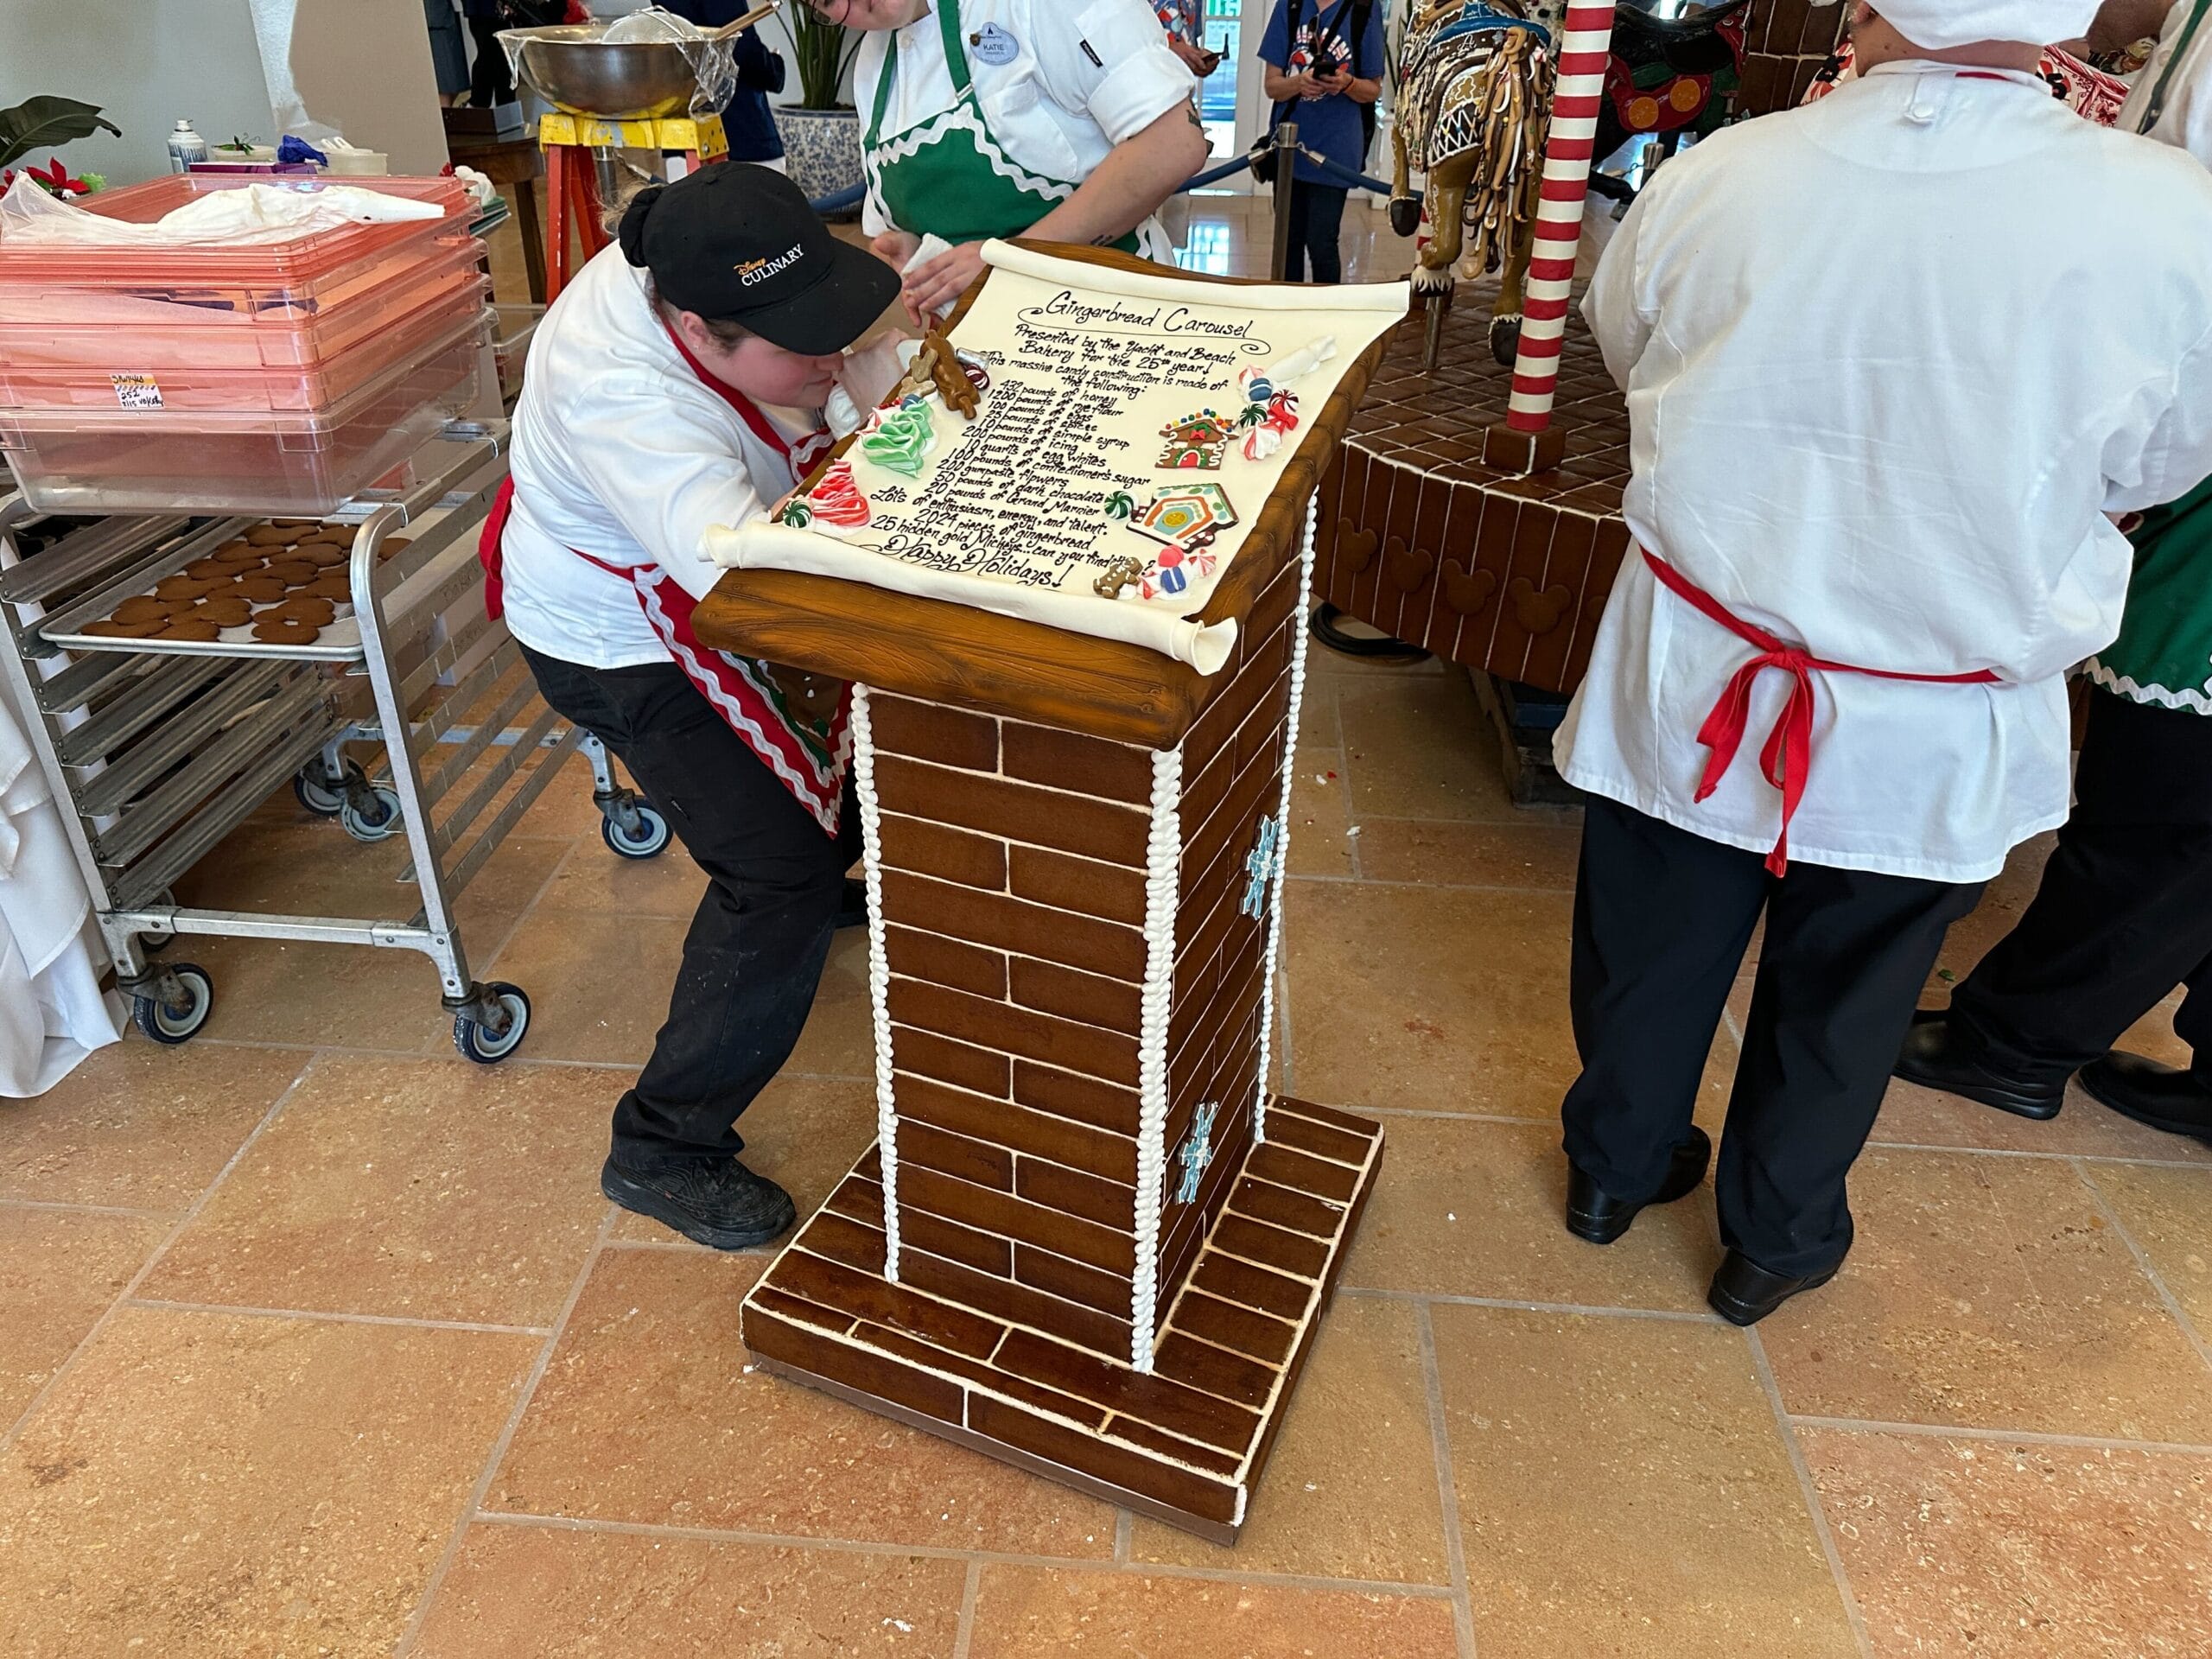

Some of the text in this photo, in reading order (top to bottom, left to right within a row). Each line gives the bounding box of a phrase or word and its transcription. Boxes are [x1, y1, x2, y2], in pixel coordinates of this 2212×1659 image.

[734, 243, 804, 287] Disney CULINARY
[1046, 290, 1253, 338] Gingerbread Carousel
[1014, 323, 1236, 365] Presented by the Yacht and Beach
[1019, 340, 1213, 375] Bakery for the 25th year!
[1009, 359, 1052, 372] massive
[1055, 365, 1090, 380] candy
[1093, 369, 1160, 385] construction
[1163, 375, 1173, 385] is
[1175, 378, 1207, 389] made
[1210, 379, 1229, 391] of
[1061, 375, 1147, 400] the following:
[988, 389, 1124, 416] 1200 pounds of rye flour
[1000, 379, 1117, 408] 432 pounds of honey
[985, 410, 1097, 432] 25 pounds of spices
[988, 401, 1093, 424] 100 pounds of eggs
[961, 425, 1078, 455] 200 pounds of icing
[979, 418, 1129, 450] 10 pounds of simple syrup
[948, 448, 1151, 489] 100 pounds of confectioner's sugar
[964, 438, 1106, 467] 10 quarts of egg whites
[934, 471, 1104, 504] 50 pounds of dark chocolate
[936, 459, 1069, 486] 200 gumpaste flowers
[870, 486, 1108, 535] Lots of enthusiasm, energy, and talent.
[924, 481, 1100, 516] 20 pounds of Grand Marnier
[871, 515, 898, 531] 25
[896, 518, 940, 538] hidden
[938, 531, 972, 546] gold
[1054, 551, 1084, 565] you
[1086, 550, 1115, 568] find
[914, 508, 1096, 550] 2024 pieces of gingerbread
[877, 534, 960, 572] Happy
[962, 548, 1074, 588] Holidays!
